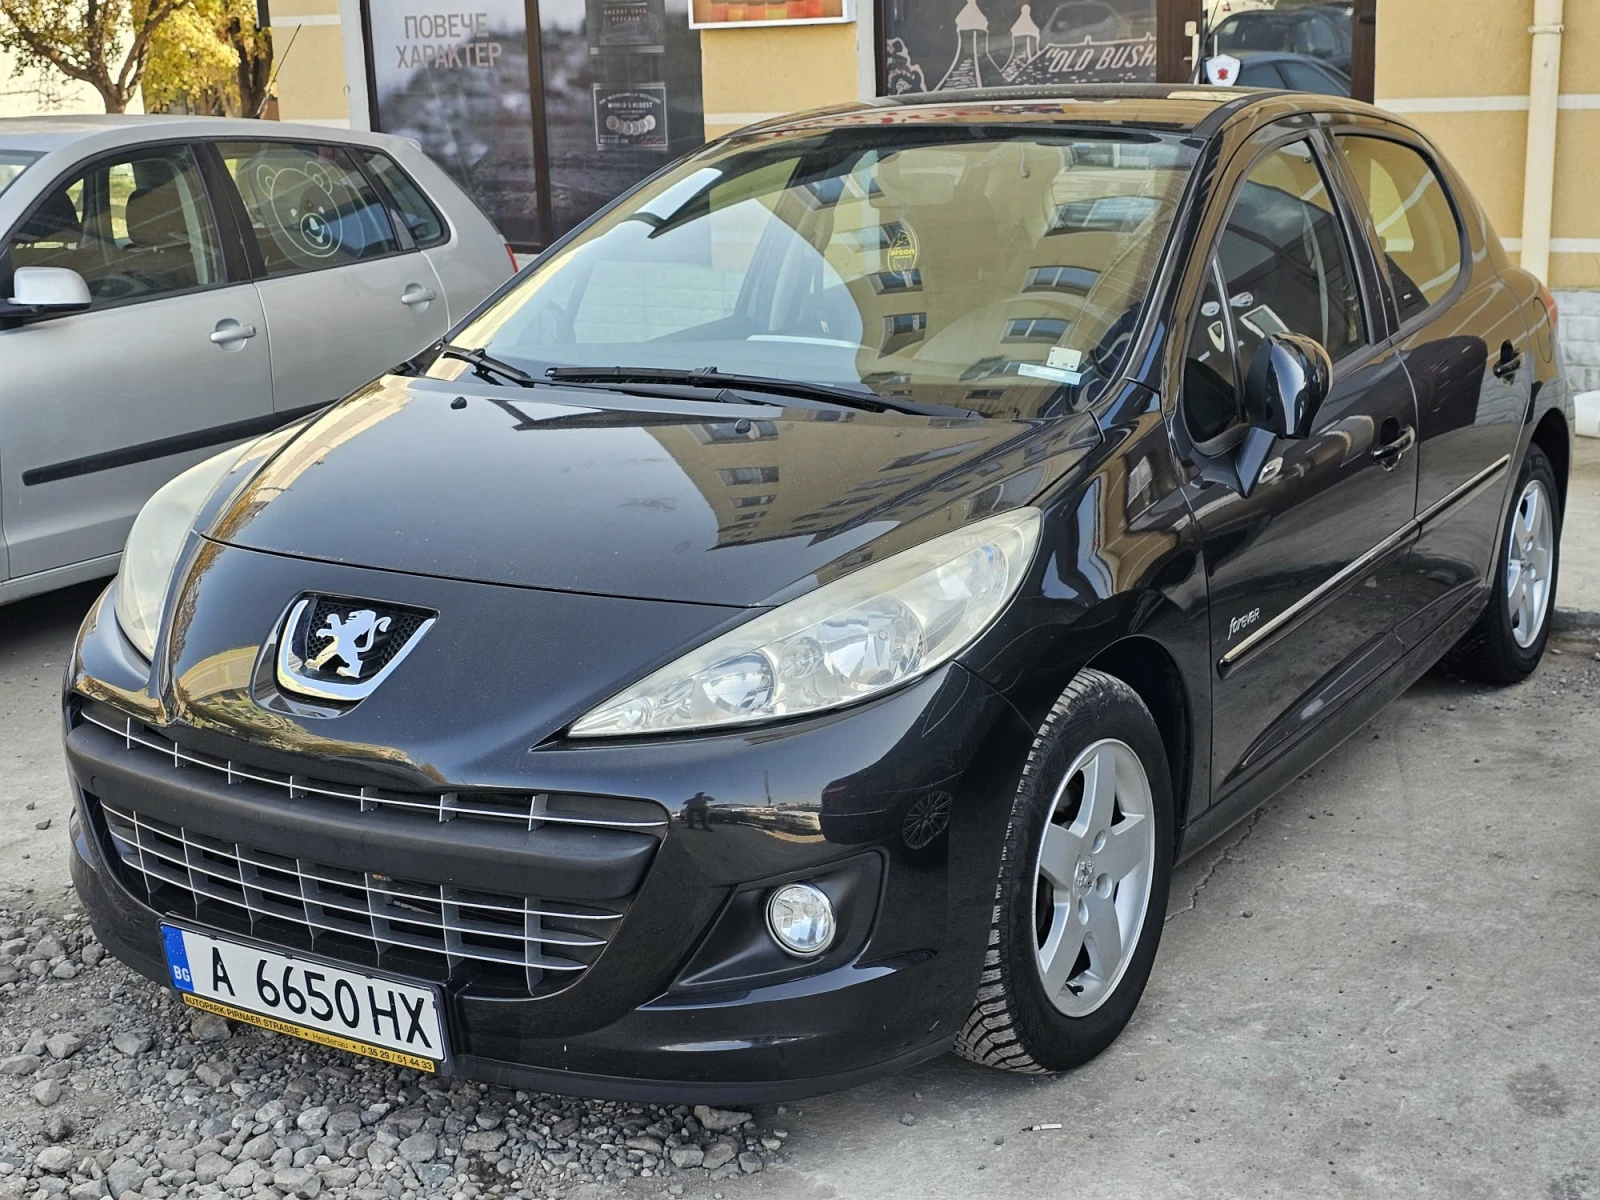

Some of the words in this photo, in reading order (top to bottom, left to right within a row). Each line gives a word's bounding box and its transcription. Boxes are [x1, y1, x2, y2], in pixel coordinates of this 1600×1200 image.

[404, 13, 489, 39] ПОВЕЧЕ
[396, 42, 502, 68] ХАРАКТЕР
[173, 965, 191, 982] BG
[212, 946, 236, 997] A
[256, 959, 360, 1029] 6650
[367, 985, 433, 1049] HX
[184, 996, 226, 1015] AUTOPARK
[226, 1008, 262, 1025] PIRNAER
[263, 1019, 301, 1036] STRASSE
[312, 1031, 349, 1050] Heidenau
[360, 1045, 367, 1054] 0
[368, 1047, 378, 1056] 35
[379, 1050, 390, 1060] 29
[397, 1055, 407, 1065] 51
[409, 1059, 420, 1067] 44
[421, 1062, 433, 1070] 33
